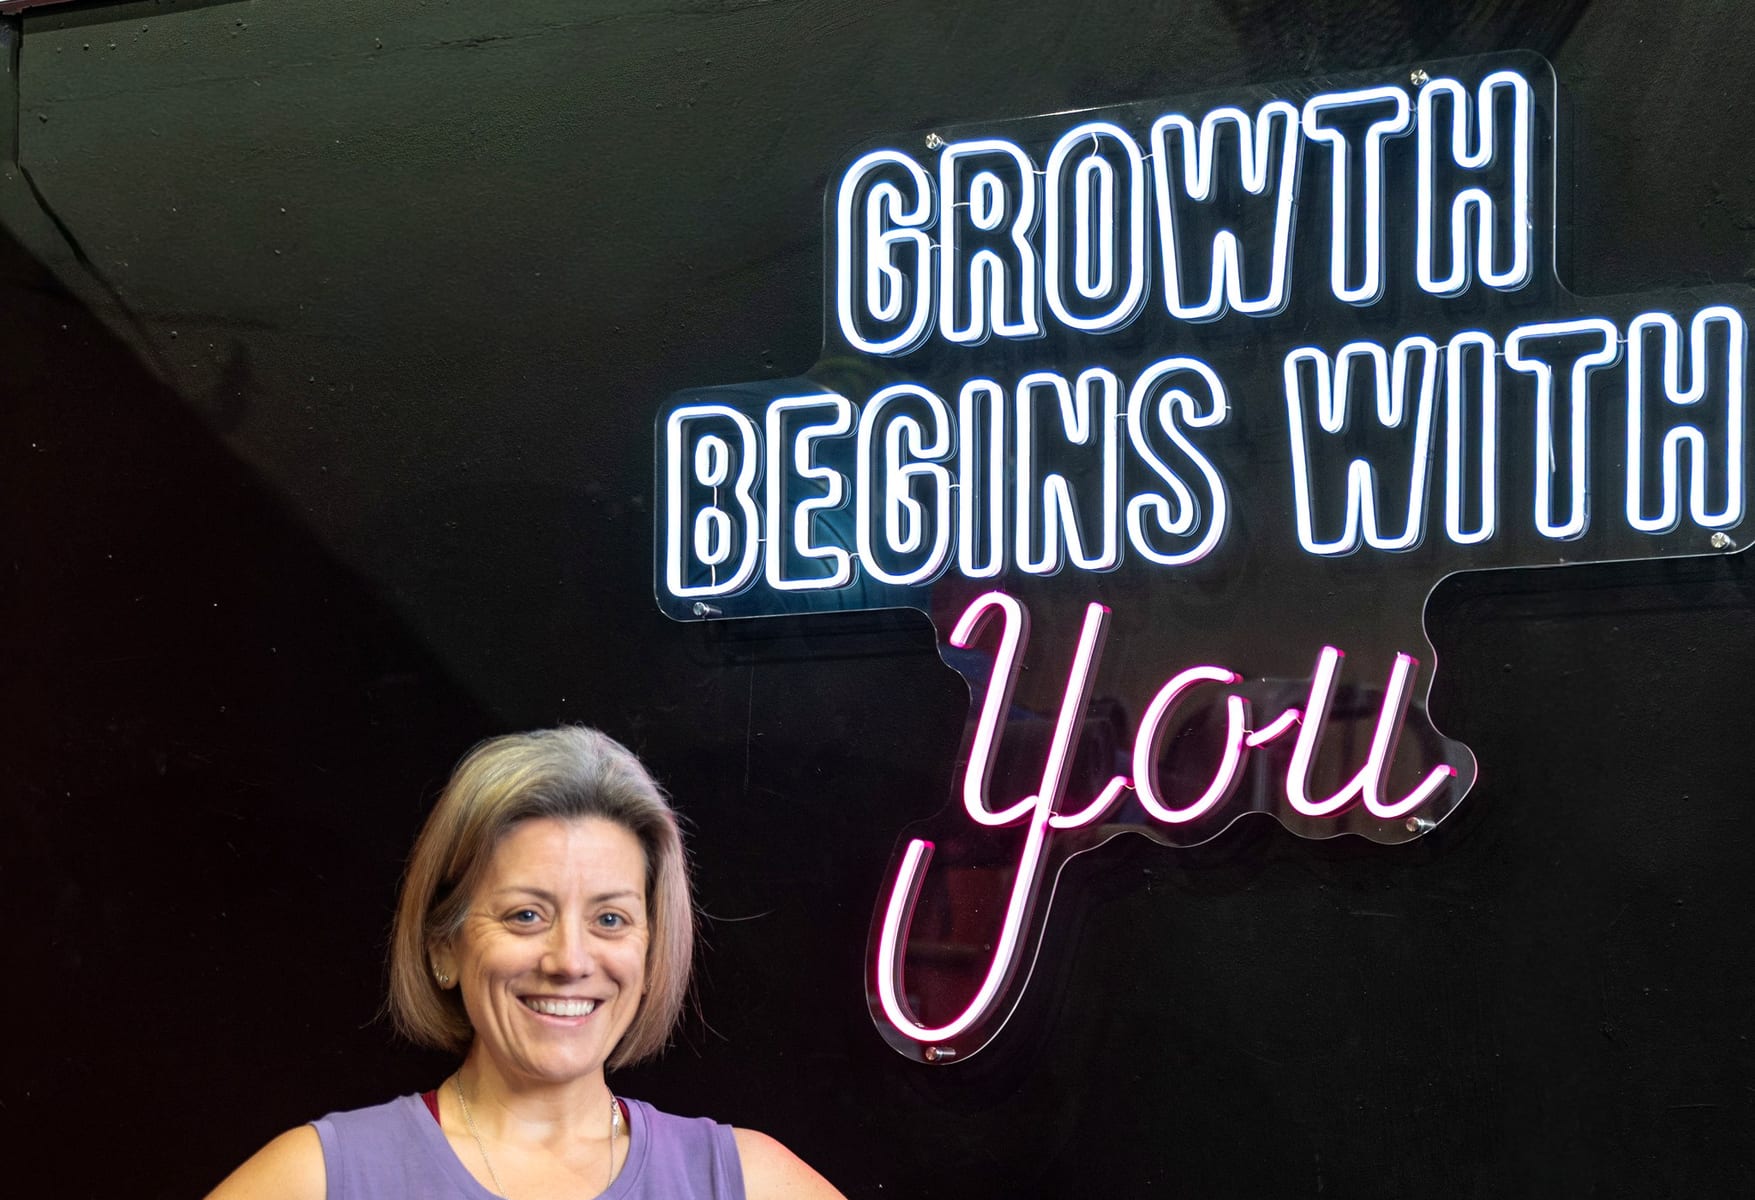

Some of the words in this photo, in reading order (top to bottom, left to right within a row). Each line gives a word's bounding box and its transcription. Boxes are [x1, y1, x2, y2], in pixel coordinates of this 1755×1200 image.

[836, 70, 1533, 354] GROWTH
[665, 357, 1228, 598] BEGINS
[1283, 305, 1746, 556] WITH
